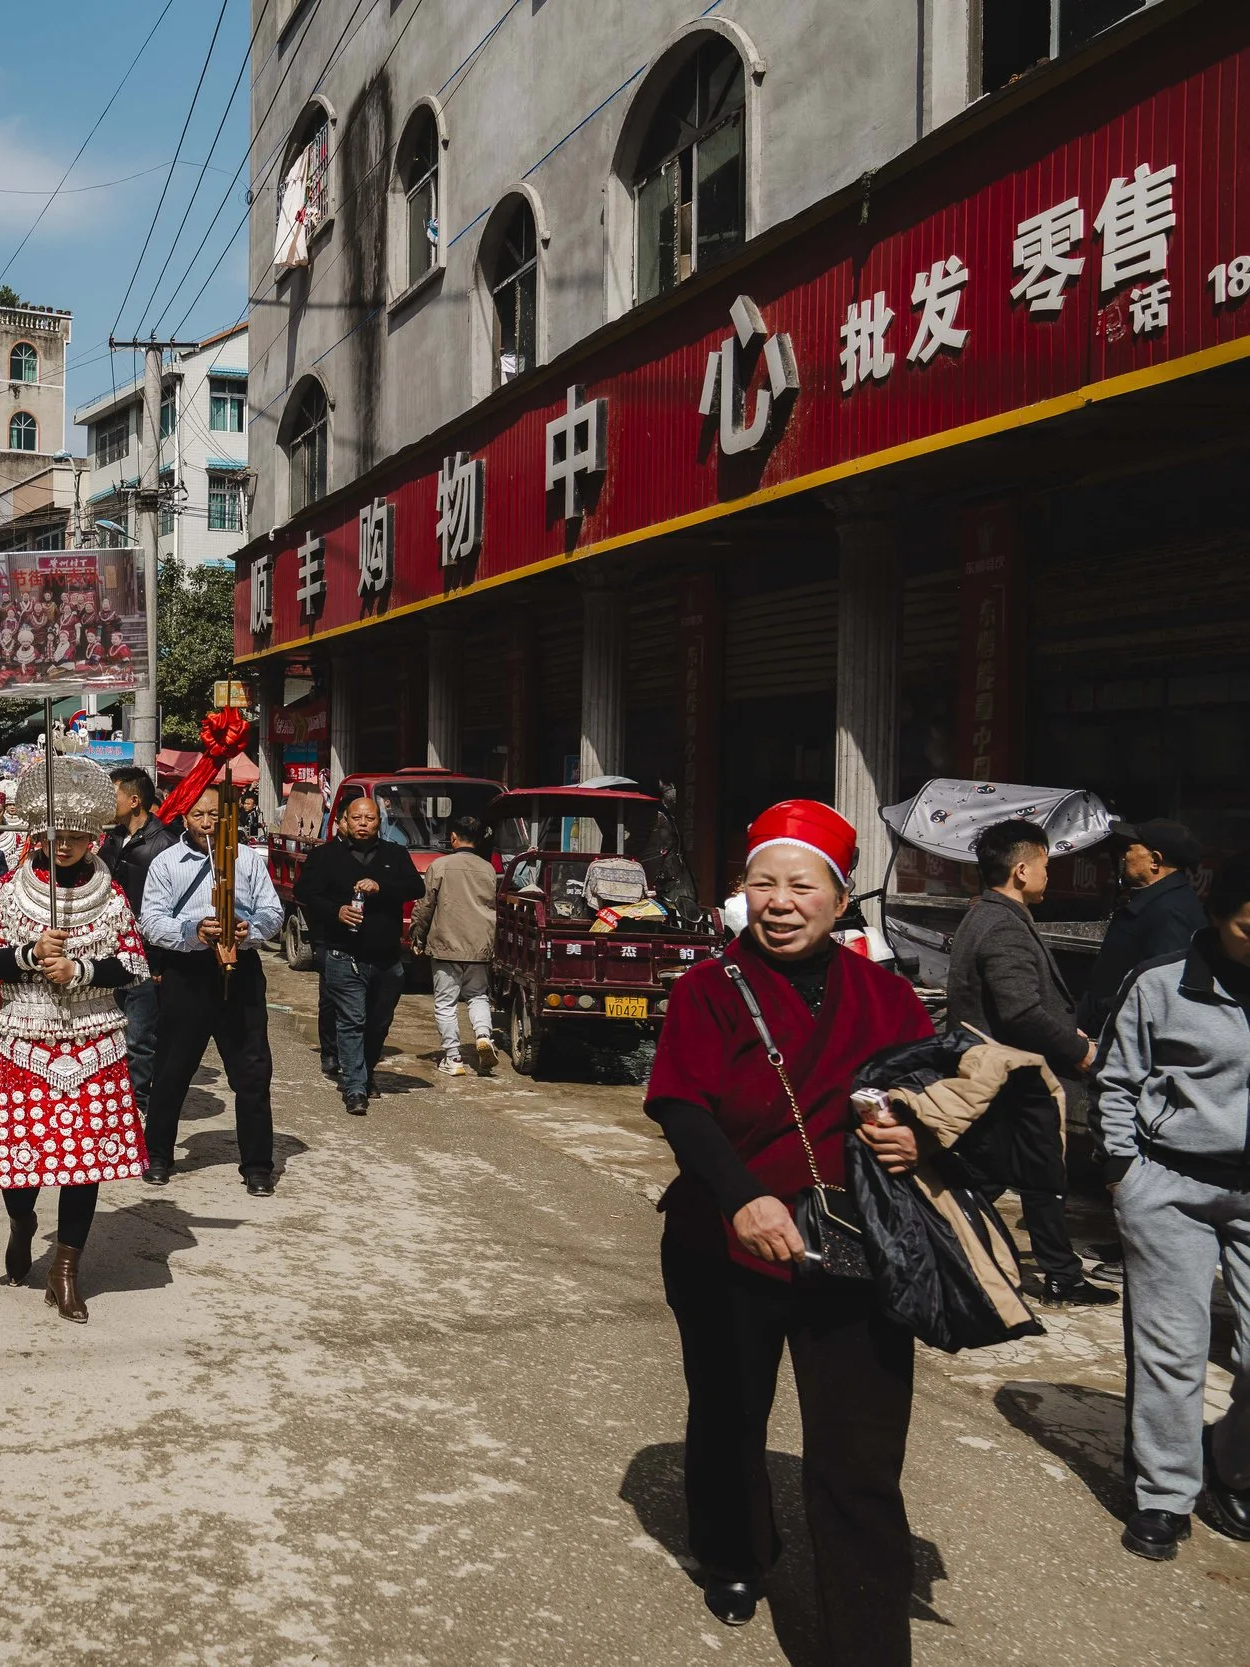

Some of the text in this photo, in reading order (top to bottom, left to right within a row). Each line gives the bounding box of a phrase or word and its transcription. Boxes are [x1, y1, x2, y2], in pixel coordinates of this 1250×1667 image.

[249, 295, 799, 635] 顺丰购物中心
[608, 1004, 645, 1017] VD427
